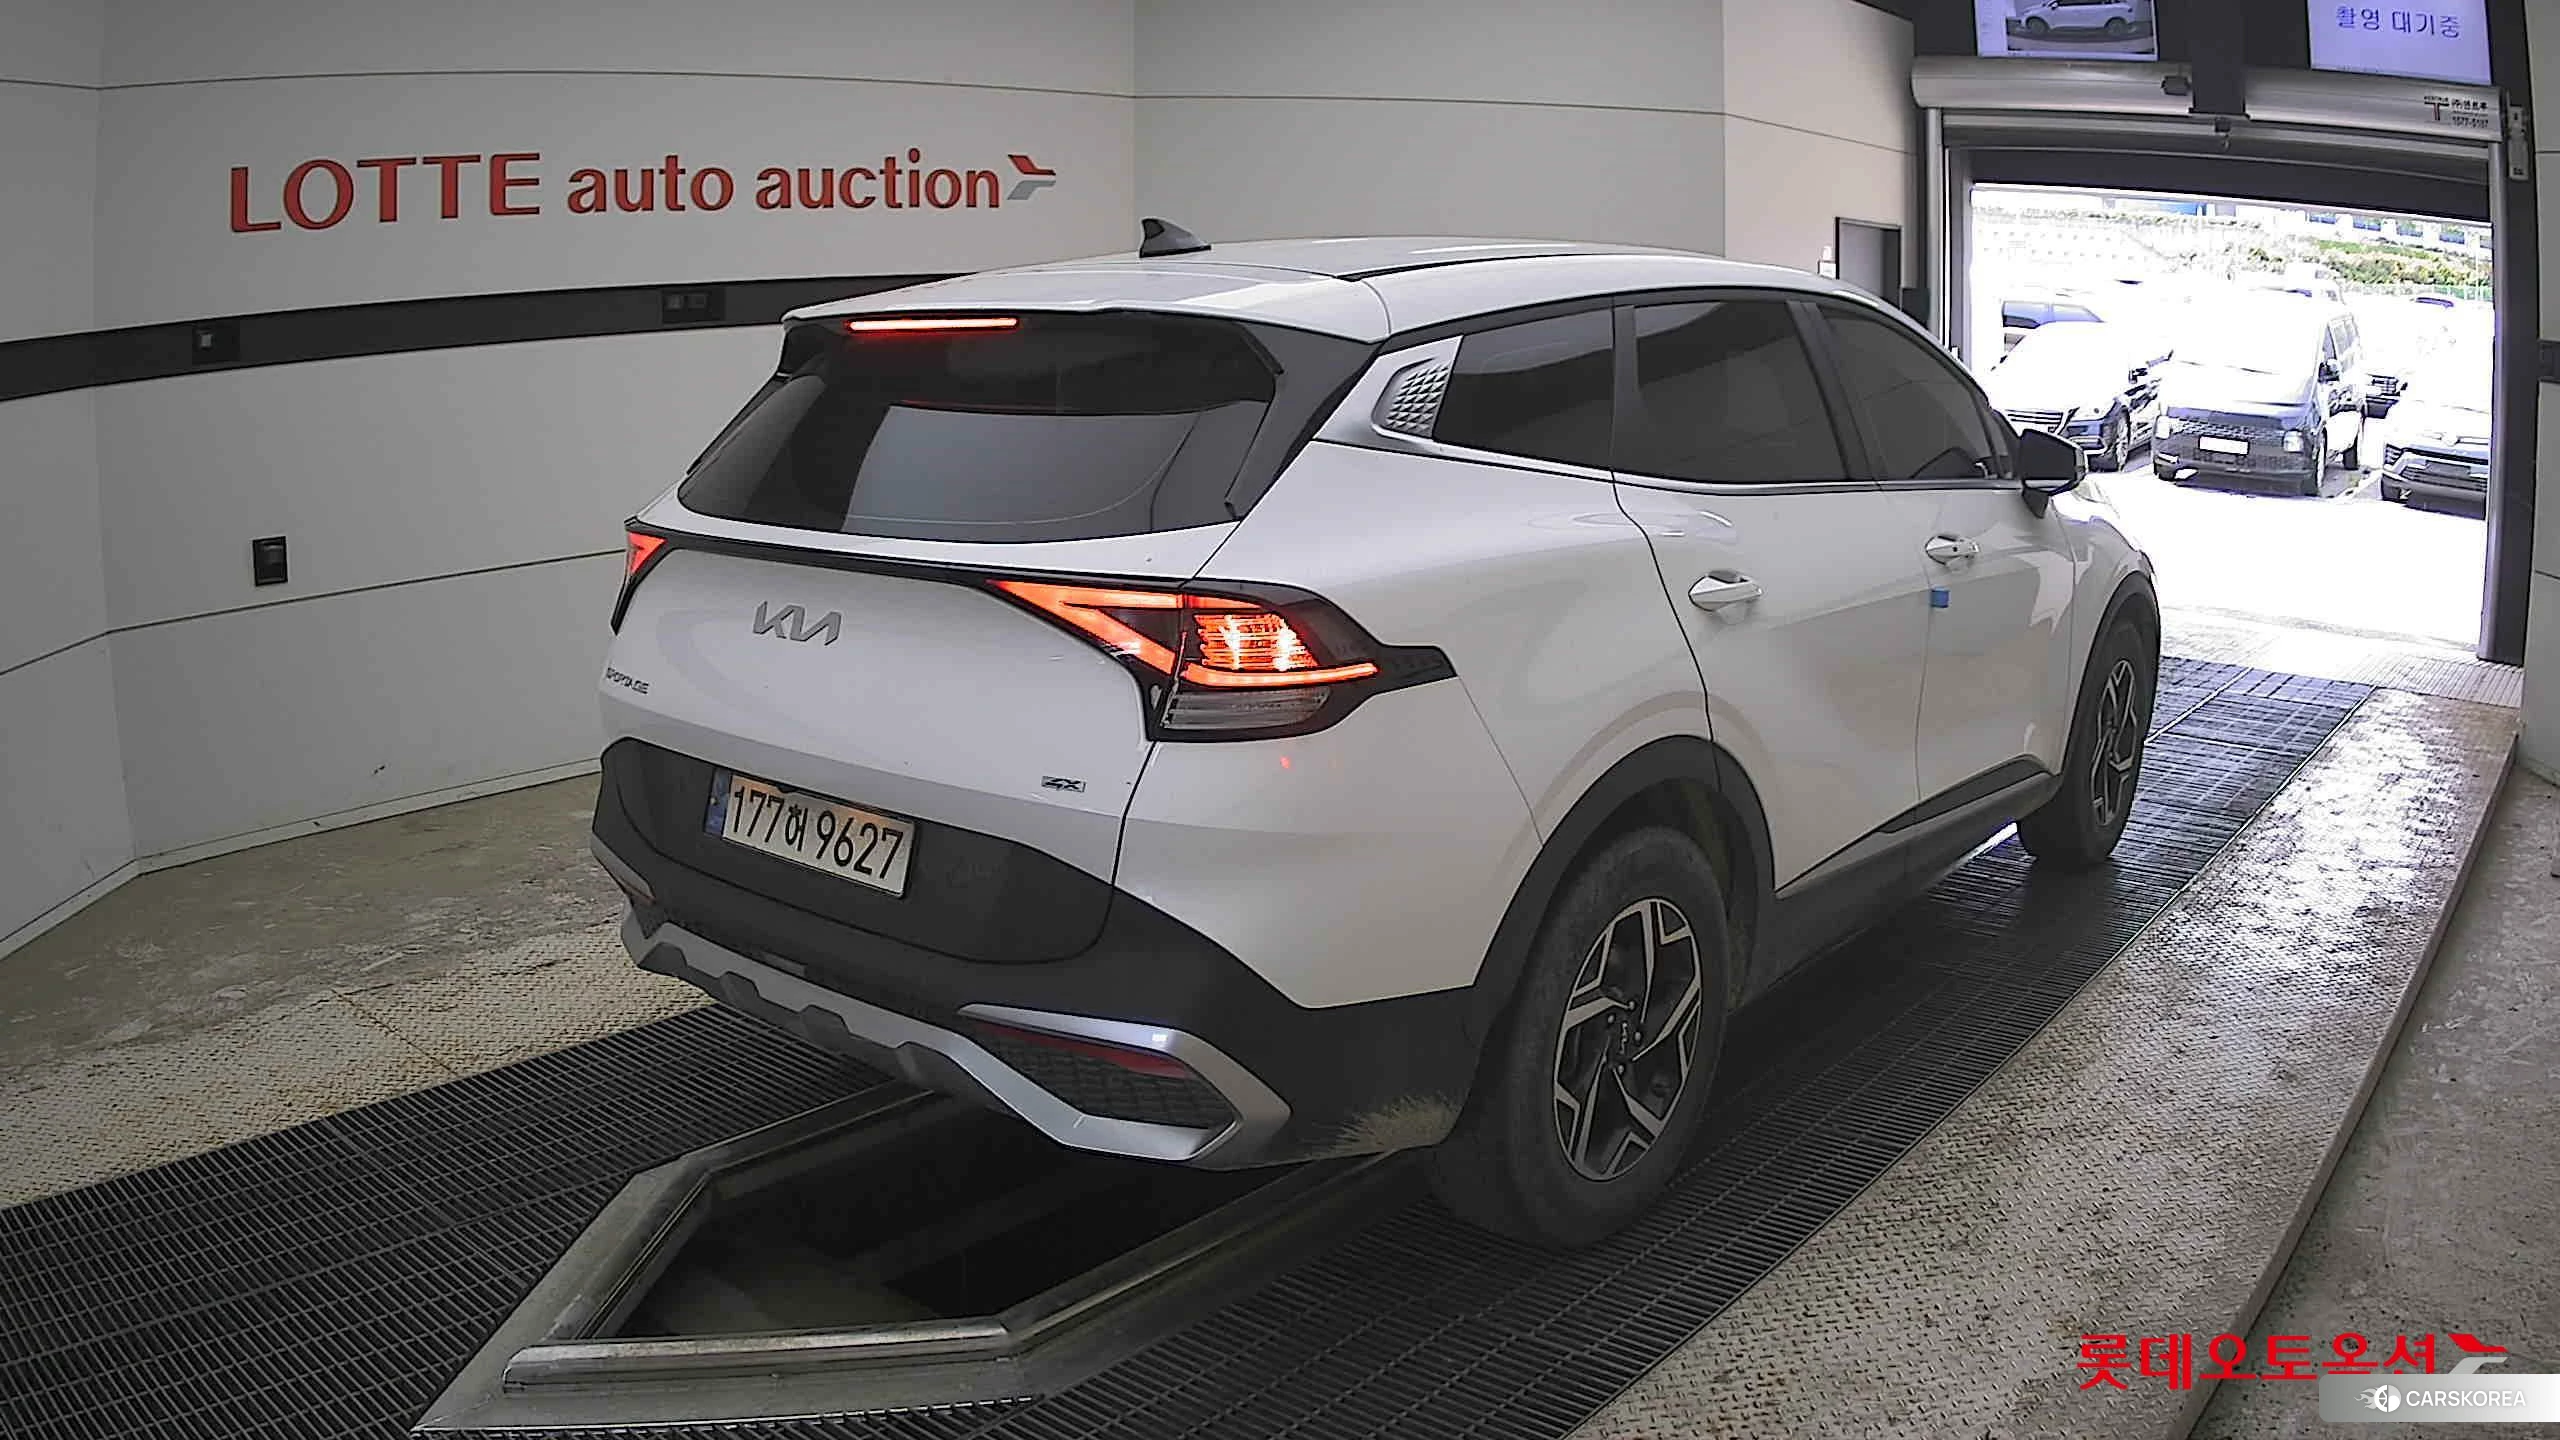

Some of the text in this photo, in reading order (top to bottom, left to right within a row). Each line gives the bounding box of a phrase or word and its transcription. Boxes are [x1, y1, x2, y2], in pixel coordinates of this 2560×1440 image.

[2336, 6, 2461, 39] 촬영 대기중
[230, 147, 1001, 233] LOTTE auto auction
[753, 600, 842, 646] KIA
[815, 810, 904, 879] 9627
